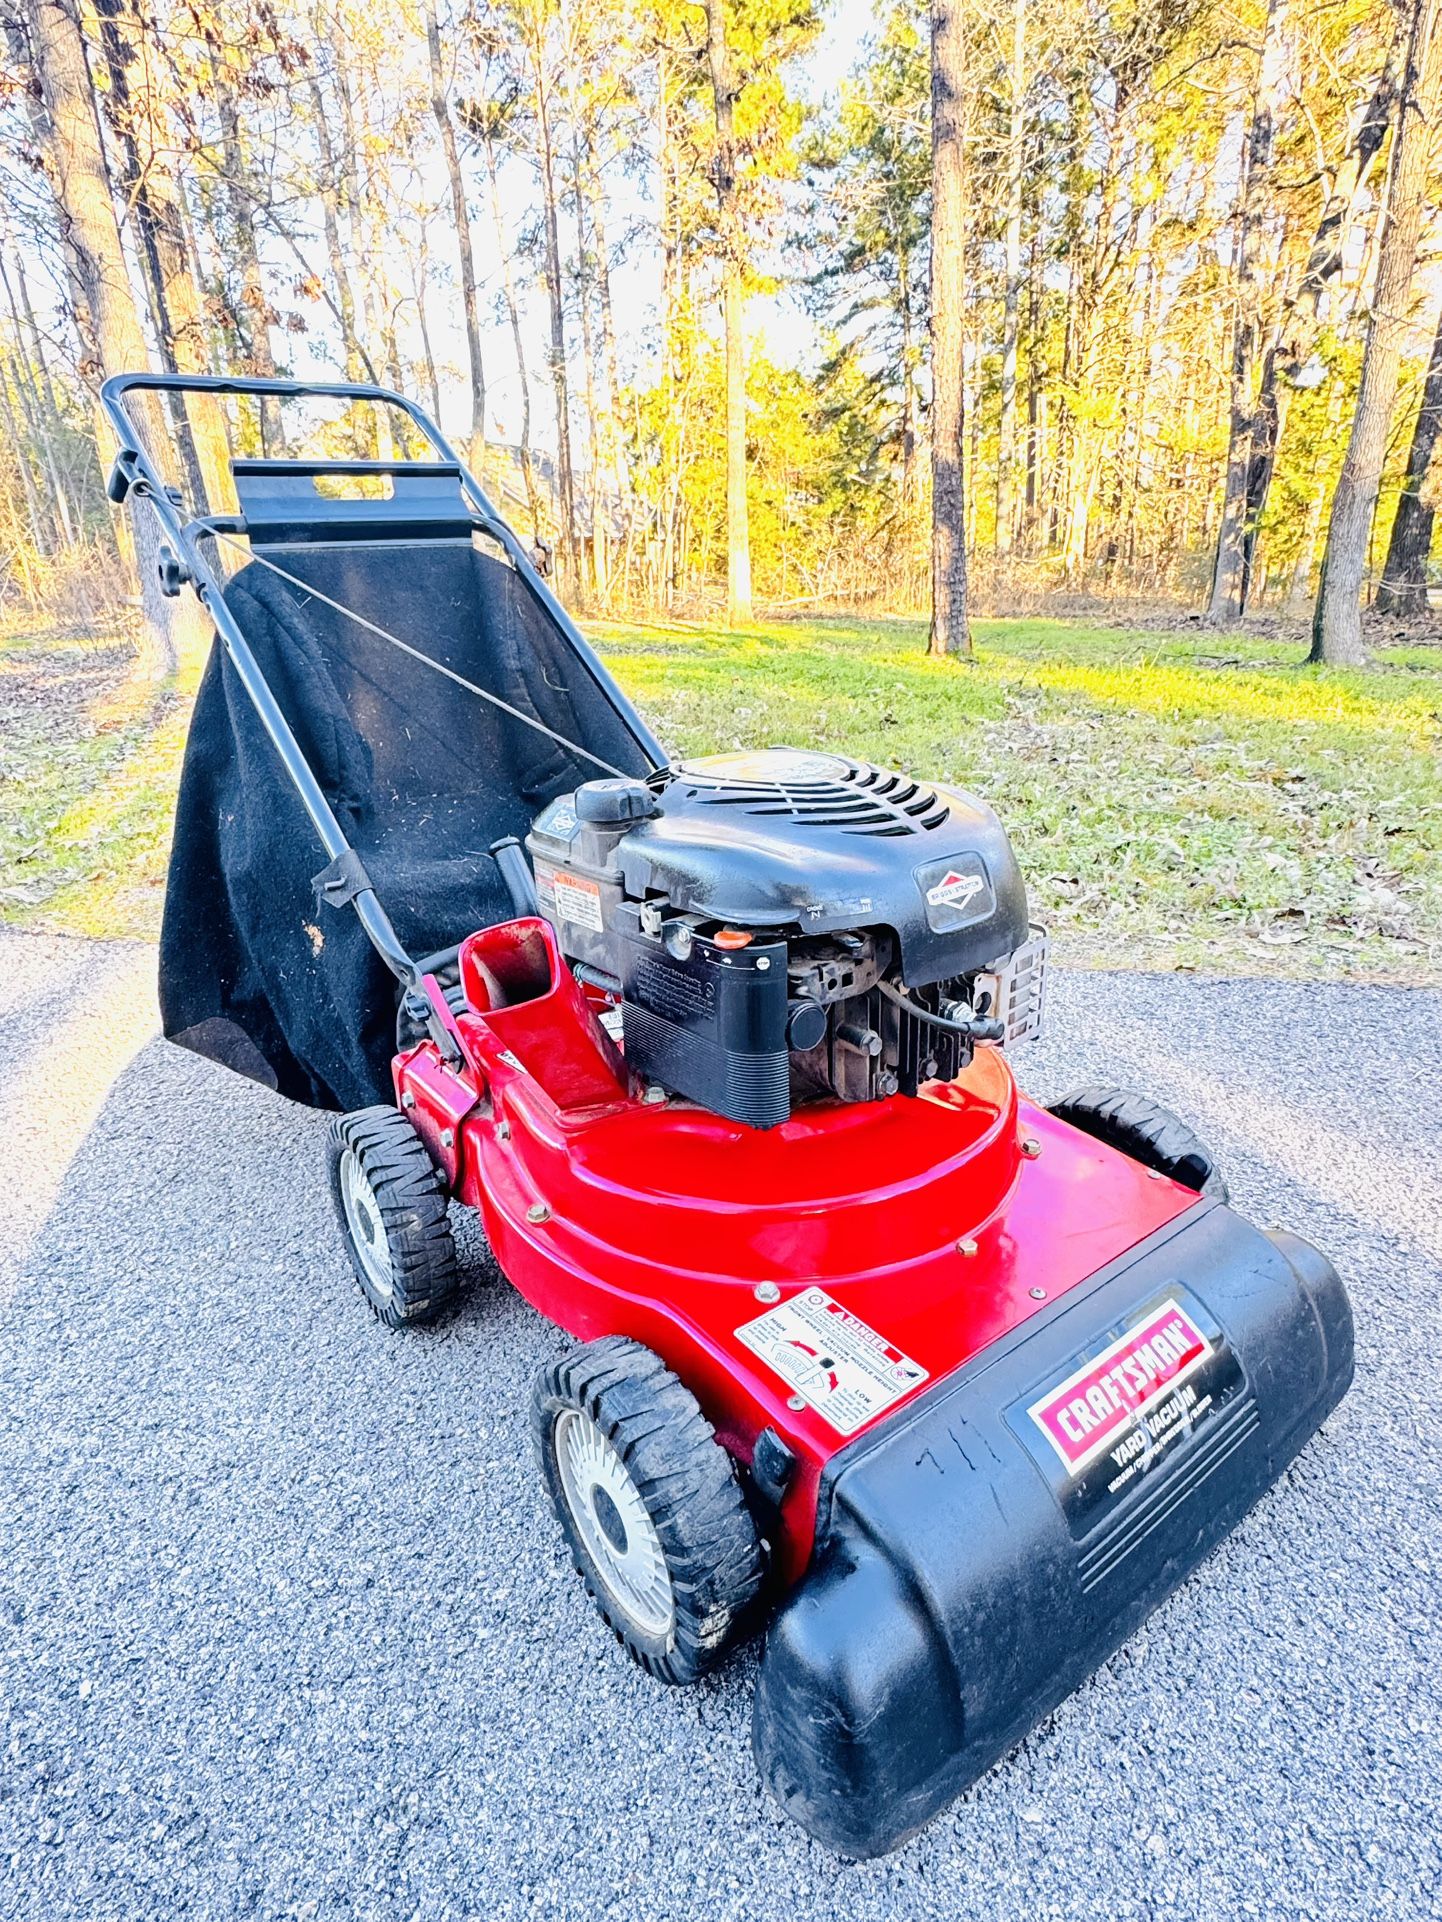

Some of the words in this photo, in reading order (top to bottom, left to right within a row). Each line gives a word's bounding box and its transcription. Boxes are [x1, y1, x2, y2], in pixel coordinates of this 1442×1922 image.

[769, 1317, 787, 1332] HIGH
[843, 1316, 890, 1352] DANGER
[819, 1339, 849, 1364] ADJUSTER
[854, 1388, 872, 1404] LOW
[1056, 1321, 1193, 1442] CRAFTSMAN
[1110, 1430, 1147, 1468] YARD
[1145, 1385, 1197, 1438] VACUUM
